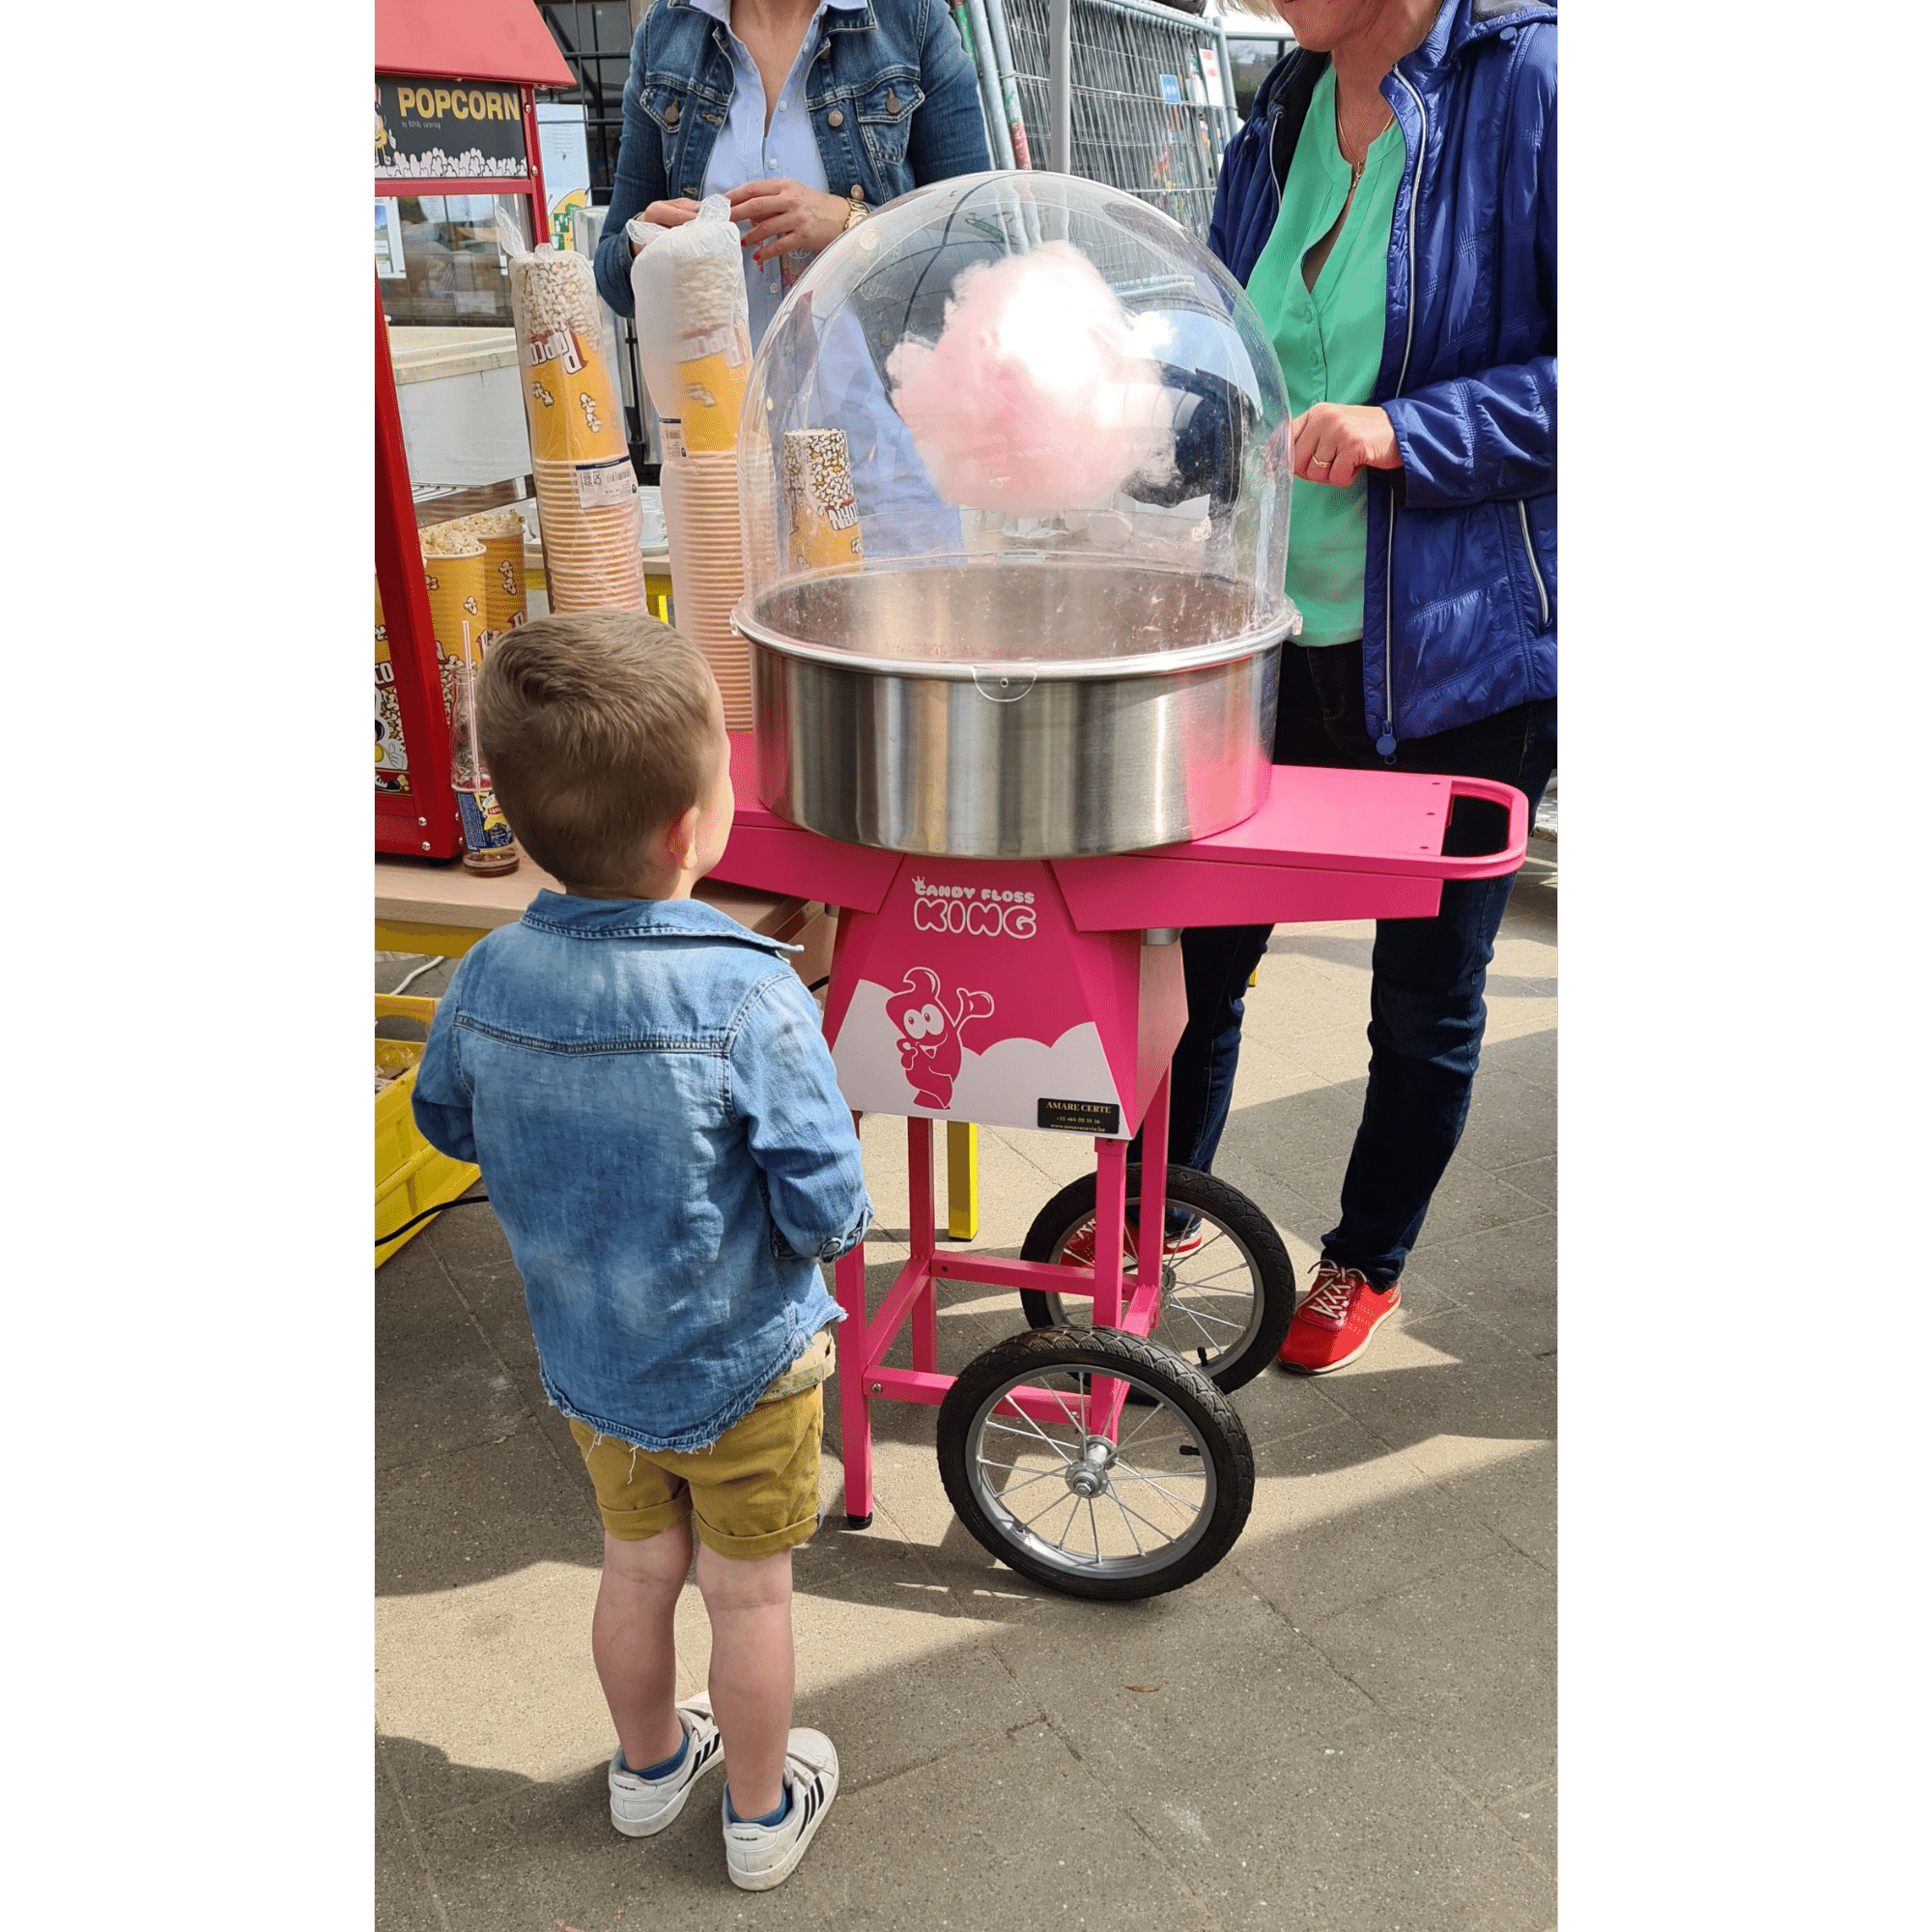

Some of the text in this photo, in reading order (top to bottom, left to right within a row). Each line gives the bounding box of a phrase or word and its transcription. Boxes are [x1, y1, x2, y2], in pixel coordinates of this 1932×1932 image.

[397, 87, 521, 121] POPCORN
[914, 882, 1036, 904] CANDY FLOSS
[914, 896, 1037, 940] KING
[1046, 1101, 1111, 1114] AMARE CERTE
